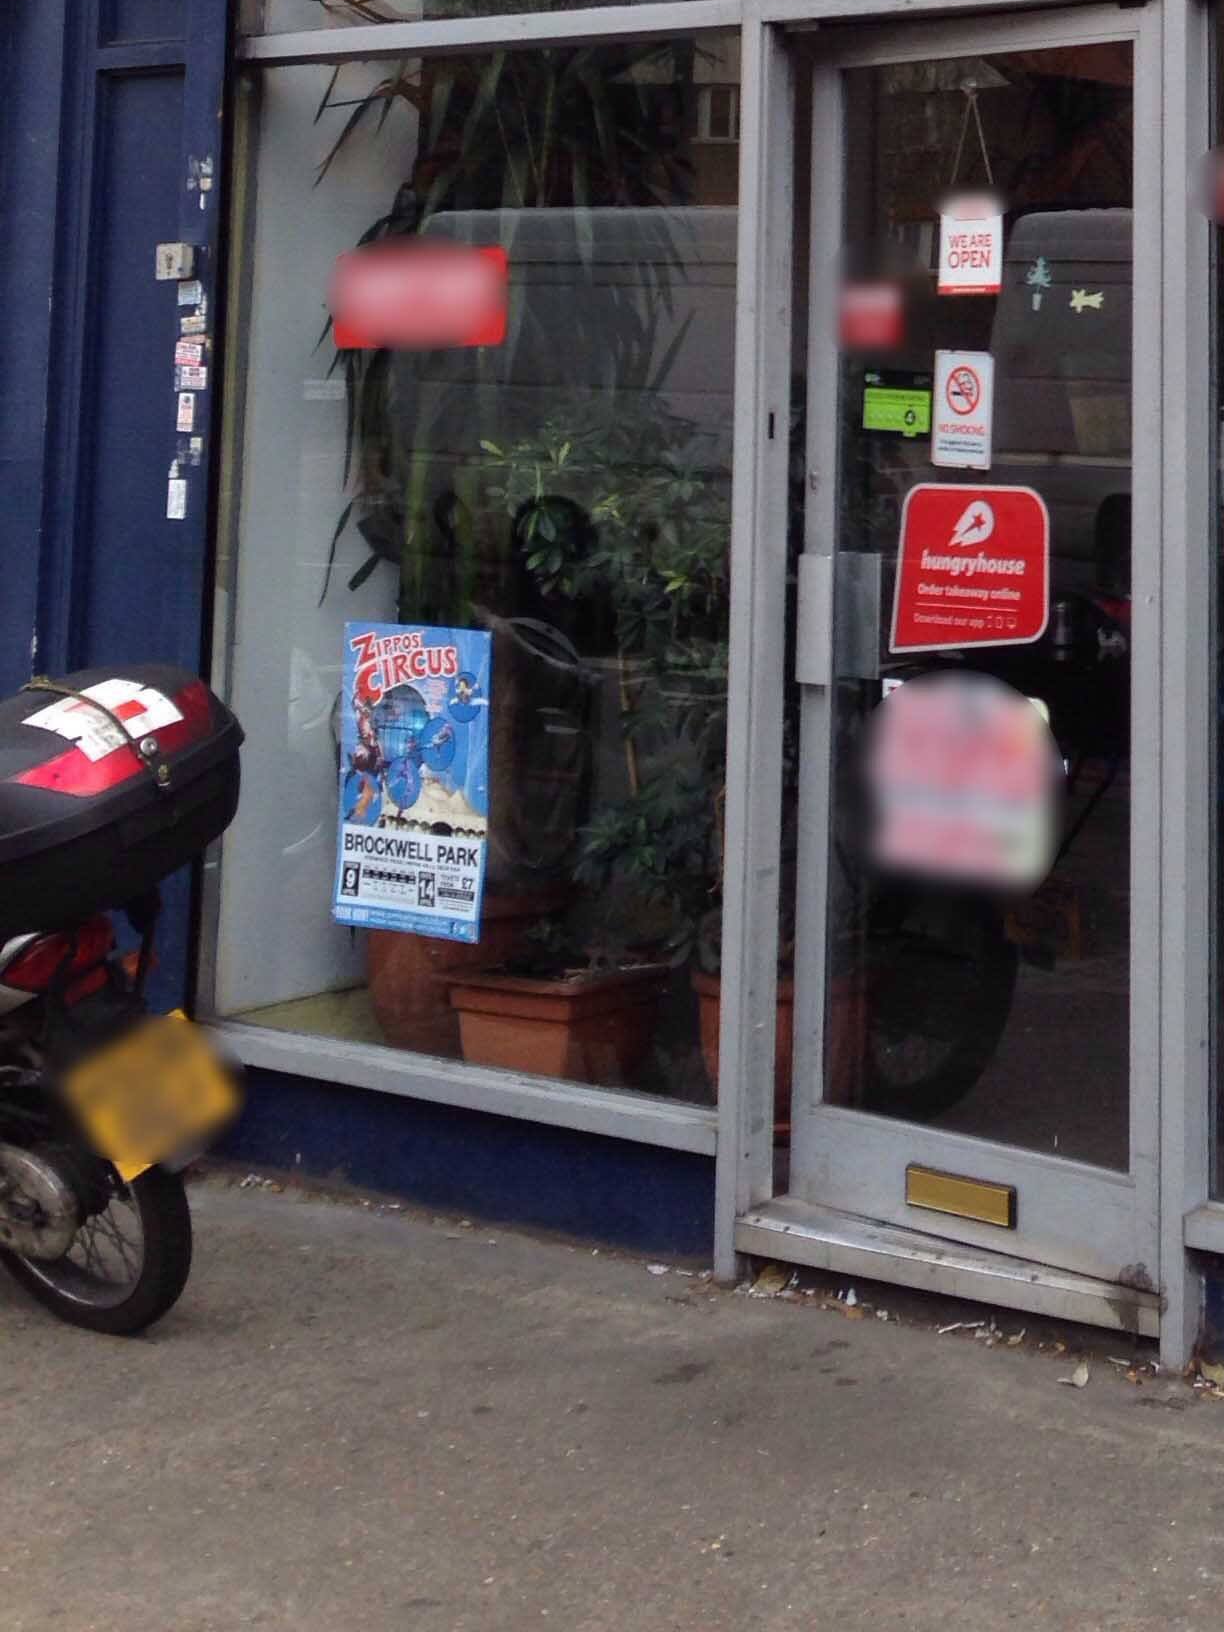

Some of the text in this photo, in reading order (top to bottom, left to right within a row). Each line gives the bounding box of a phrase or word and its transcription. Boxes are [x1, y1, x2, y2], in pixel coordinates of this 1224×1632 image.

[948, 234, 992, 248] WE ARE
[948, 250, 991, 268] OPEN
[920, 549, 1026, 577] hungryhouse
[355, 647, 456, 704] CIRCUS
[344, 833, 433, 862] BROCKWELL
[437, 844, 479, 867] PARK
[345, 868, 357, 888] 9
[419, 879, 434, 898] 14
